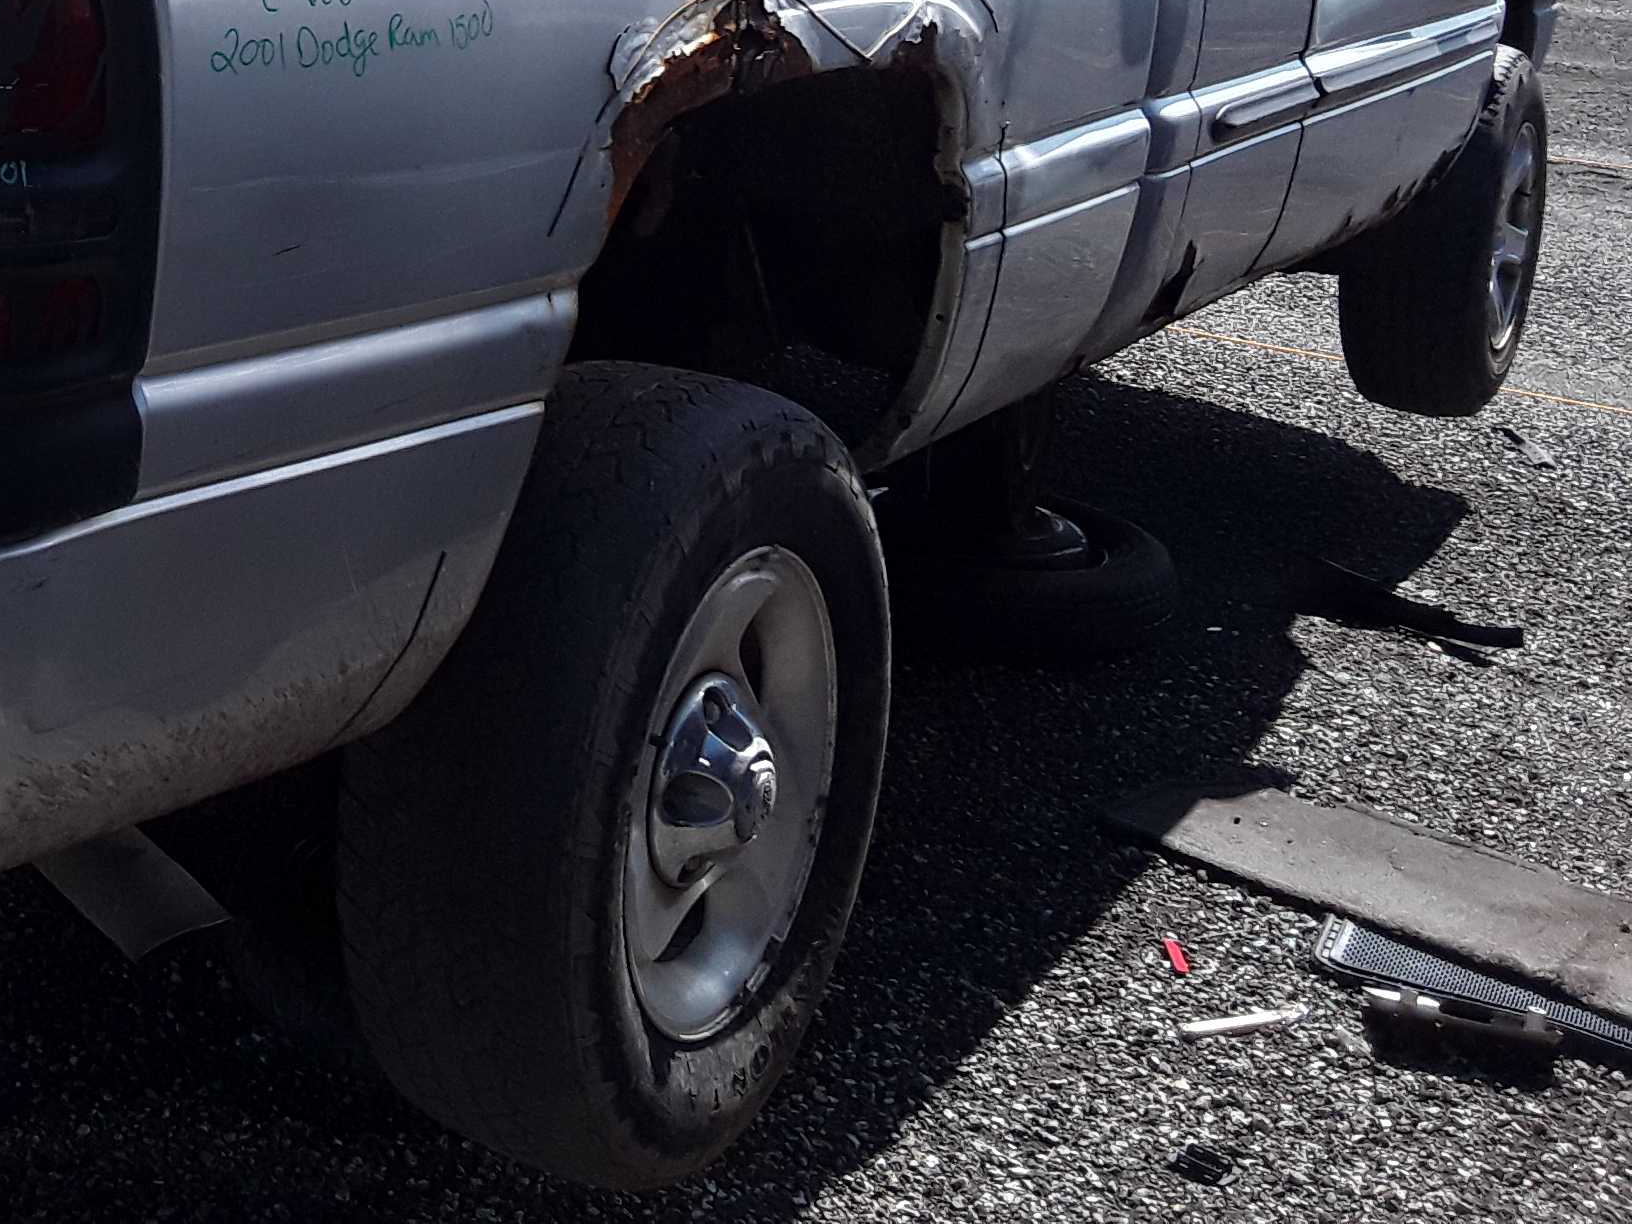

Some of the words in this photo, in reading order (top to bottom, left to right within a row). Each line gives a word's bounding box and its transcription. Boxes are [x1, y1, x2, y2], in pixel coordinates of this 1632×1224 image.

[210, 27, 287, 75] 2001
[297, 21, 381, 76] Dodge
[387, 12, 441, 50] Ram
[448, 0, 495, 42] 1500
